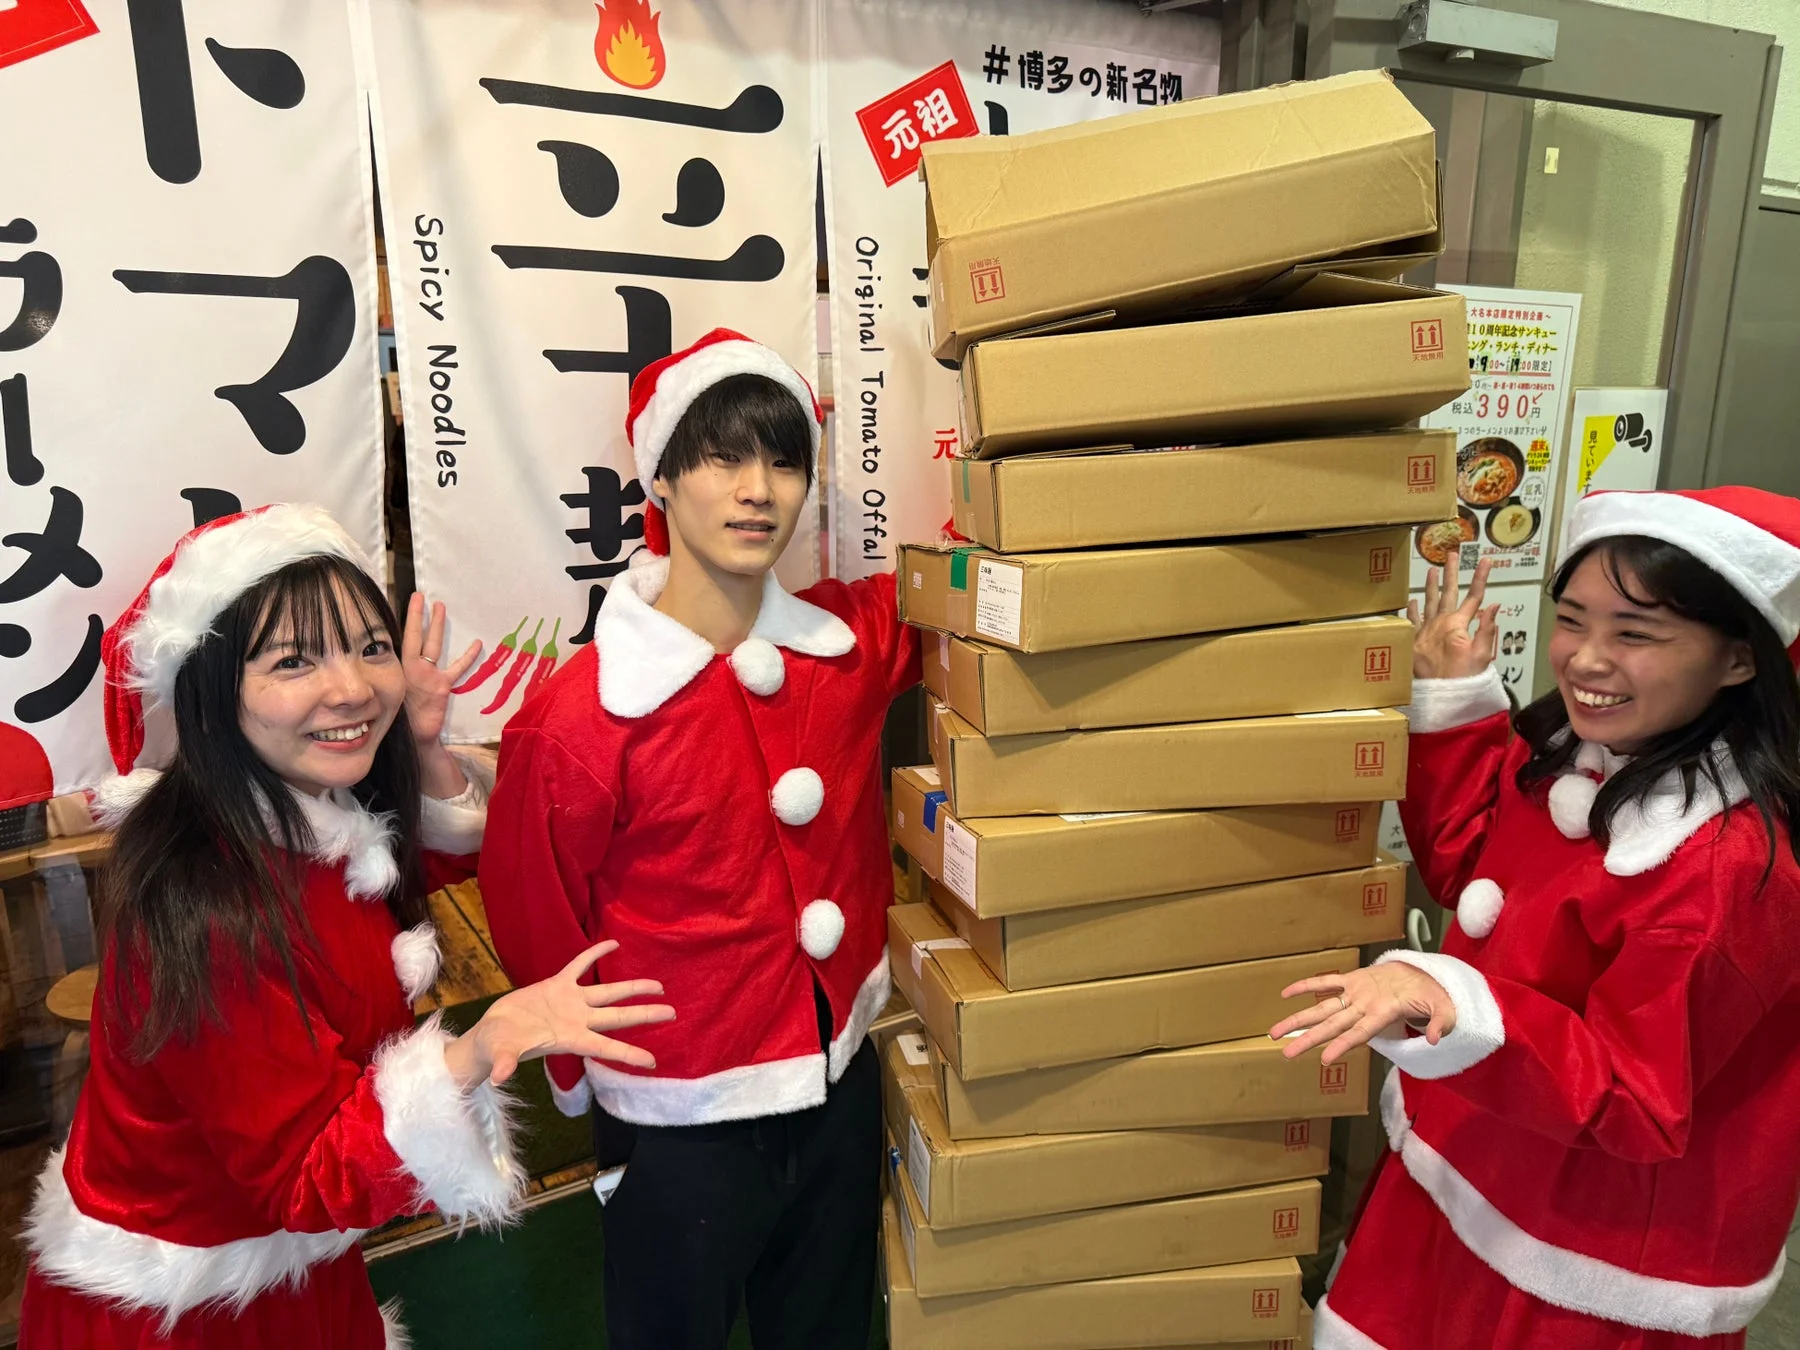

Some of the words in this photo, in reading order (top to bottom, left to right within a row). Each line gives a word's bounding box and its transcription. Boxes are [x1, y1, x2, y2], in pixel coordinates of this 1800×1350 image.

[881, 87, 959, 160] 元祖
[983, 44, 1184, 106] #博多の新名物
[113, 0, 355, 526] トマ
[413, 214, 444, 322] Spicy
[854, 235, 885, 353] Original
[1467, 339, 1558, 355] ング・ランチ・ディナー
[427, 344, 467, 488] Noodles
[860, 371, 887, 474] Tomato
[862, 489, 888, 561] Offal
